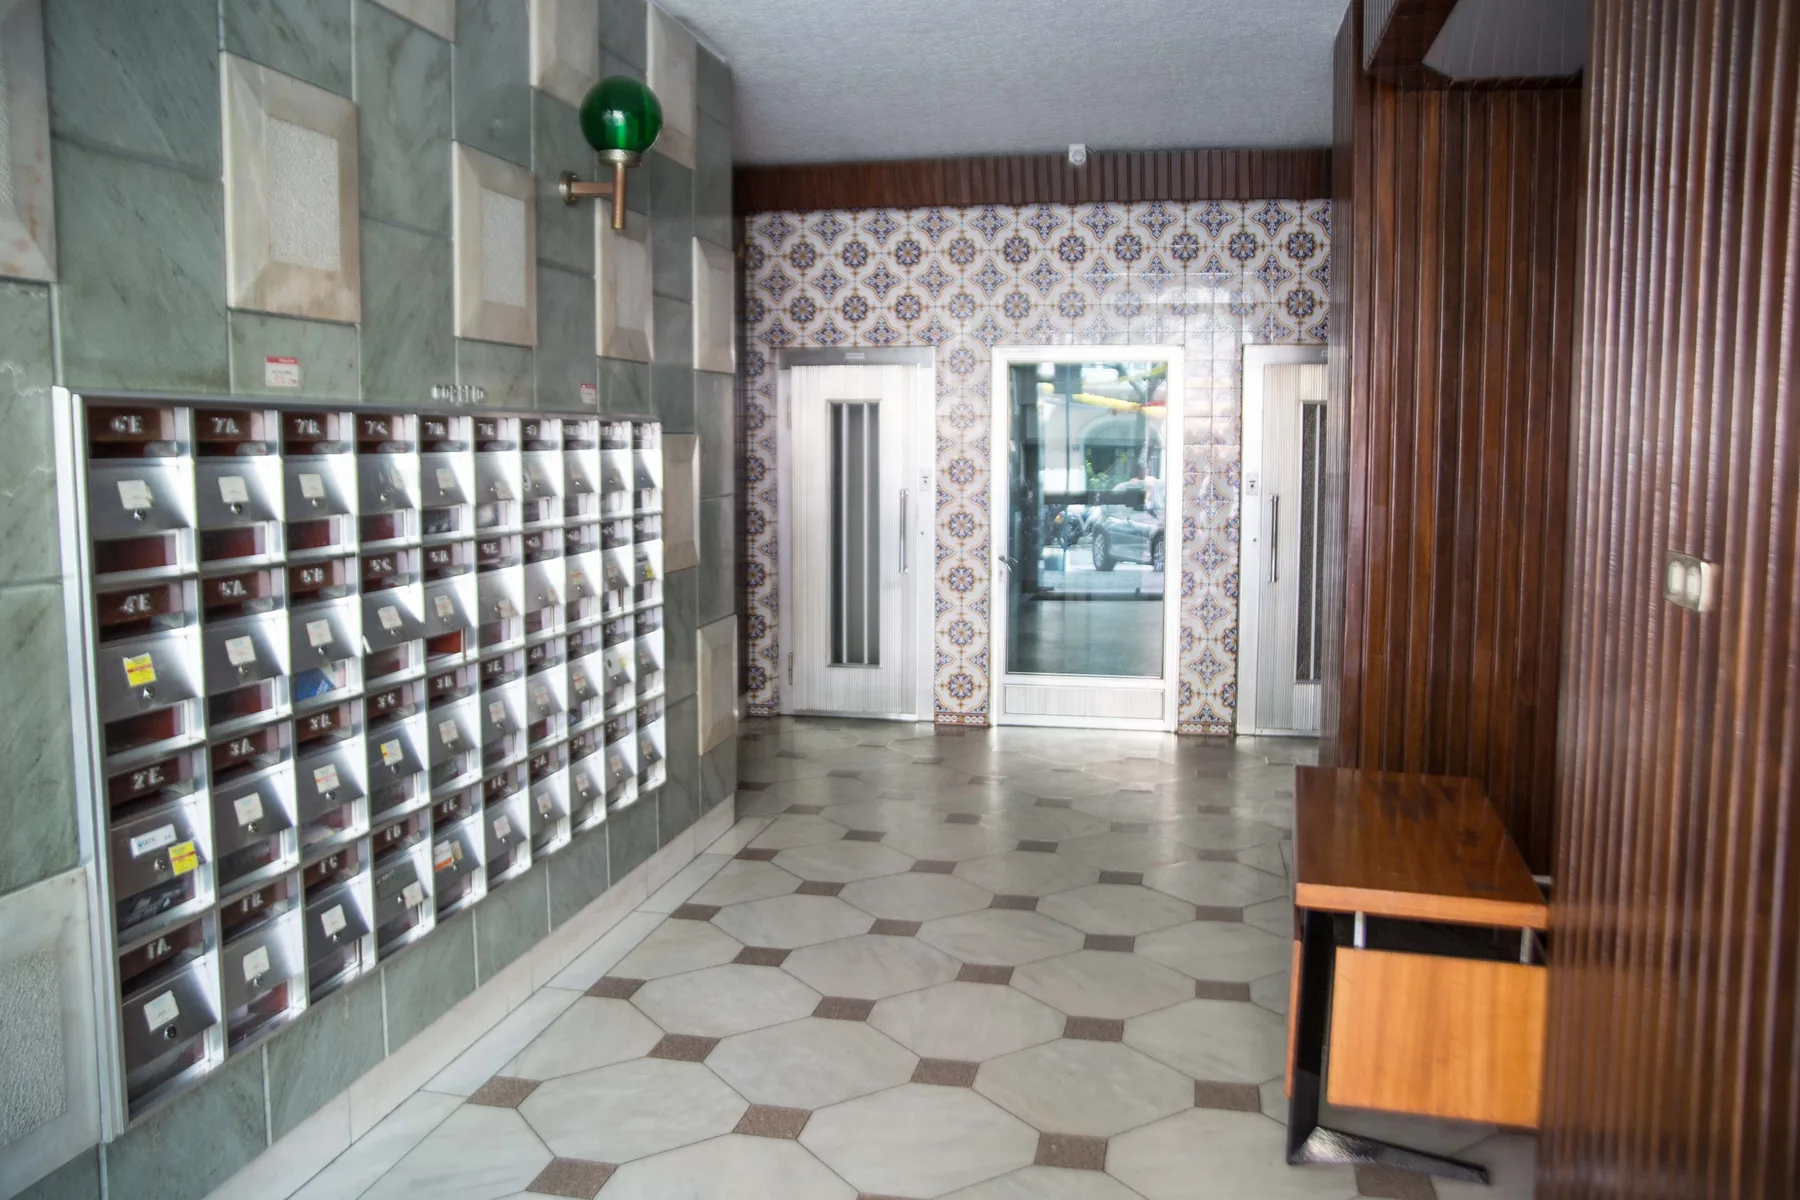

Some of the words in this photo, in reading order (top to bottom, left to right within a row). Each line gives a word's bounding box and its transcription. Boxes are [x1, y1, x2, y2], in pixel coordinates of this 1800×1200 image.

[110, 415, 143, 434] 6E
[211, 416, 240, 434] 7A
[370, 557, 393, 572] 5C
[301, 567, 324, 584] 5B
[220, 580, 247, 597] 5A
[121, 593, 151, 614] 4E
[229, 738, 255, 757] 3A
[133, 766, 165, 791] 2E
[147, 937, 172, 961] 1A
